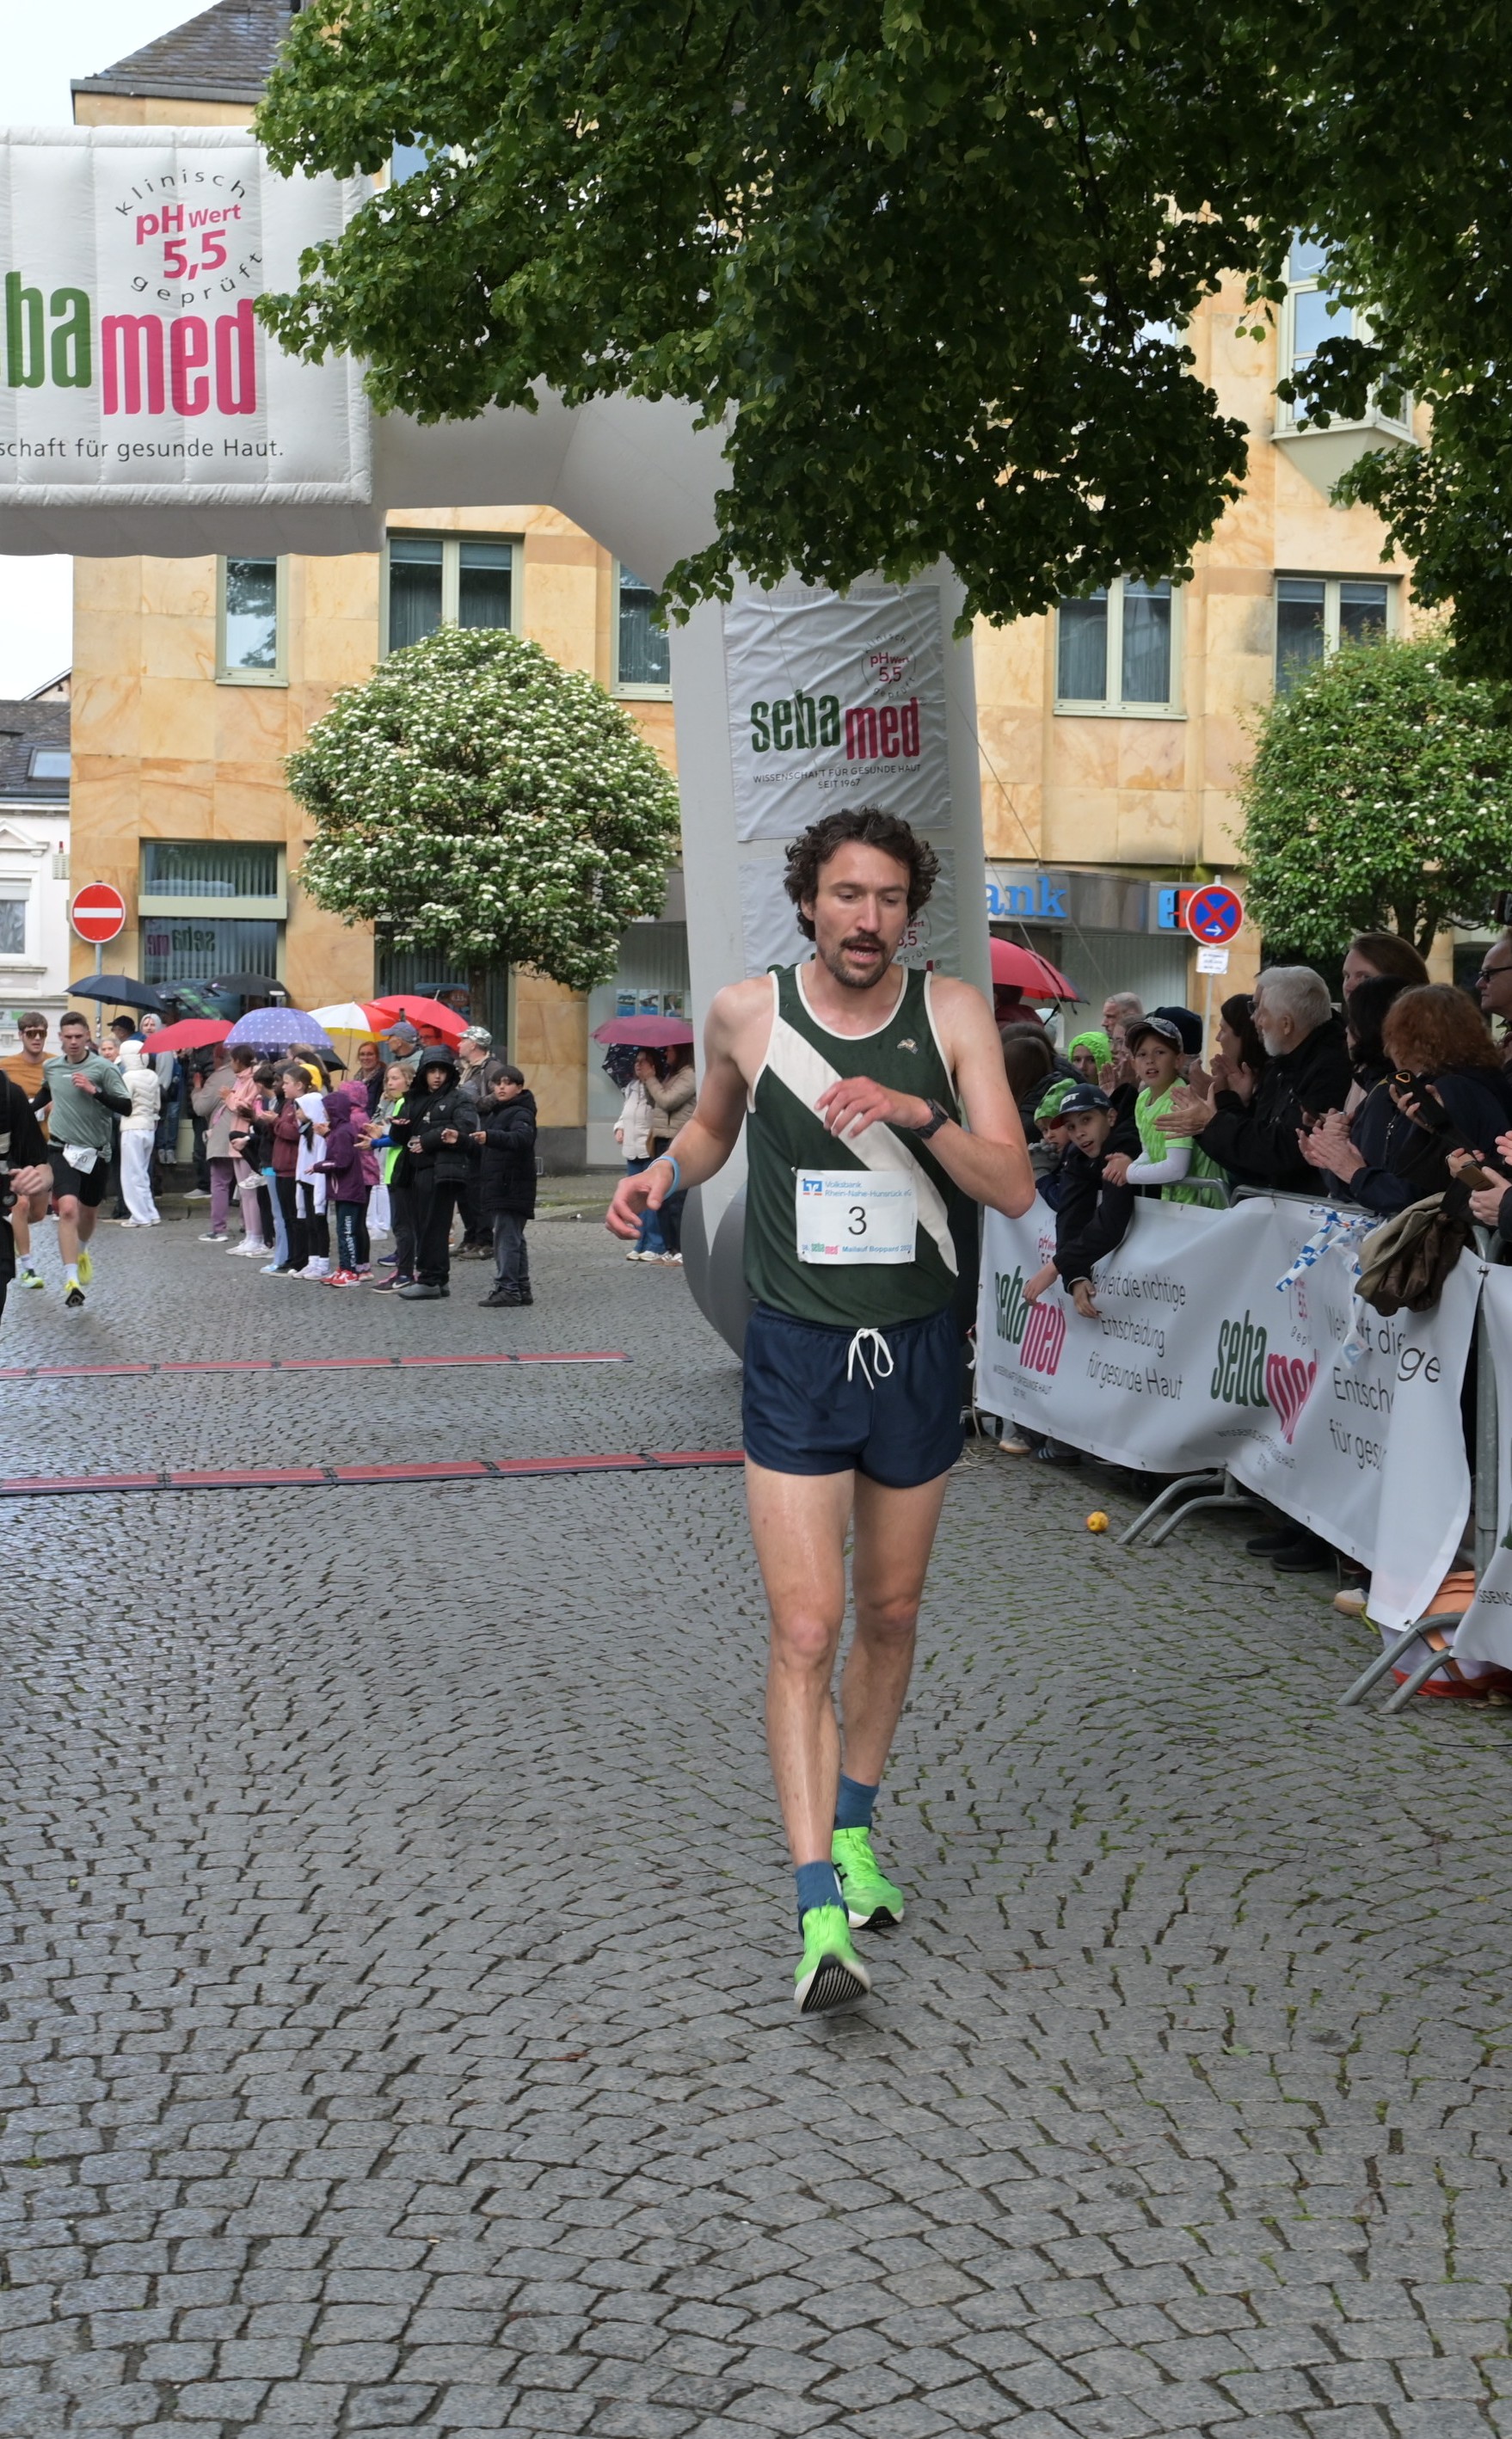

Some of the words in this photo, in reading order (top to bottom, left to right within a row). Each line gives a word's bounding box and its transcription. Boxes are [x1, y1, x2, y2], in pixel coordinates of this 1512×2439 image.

[115, 169, 246, 216] klinisch
[163, 229, 227, 280] 5,5
[131, 253, 262, 307] geprüft
[75, 437, 108, 458] für
[117, 438, 213, 462] gesunde
[224, 439, 284, 458] Haut.
[879, 667, 901, 685] 5,5
[818, 780, 838, 789] SEIT
[840, 778, 861, 788] 1967
[828, 767, 848, 777] FÜR
[851, 765, 897, 776] GESUNDE
[898, 764, 921, 773] HAUT
[985, 875, 1068, 918] ank
[848, 1206, 867, 1235] 3
[1122, 1270, 1141, 1299] die
[1141, 1273, 1186, 1312] richtige
[1097, 1311, 1165, 1358] Entscheidung
[1086, 1351, 1102, 1379] für
[1101, 1363, 1142, 1393] gesunde
[1146, 1367, 1183, 1401] Haut
[1334, 1367, 1394, 1414] Entsch
[1330, 1419, 1352, 1455] für
[1355, 1436, 1387, 1470] ges
